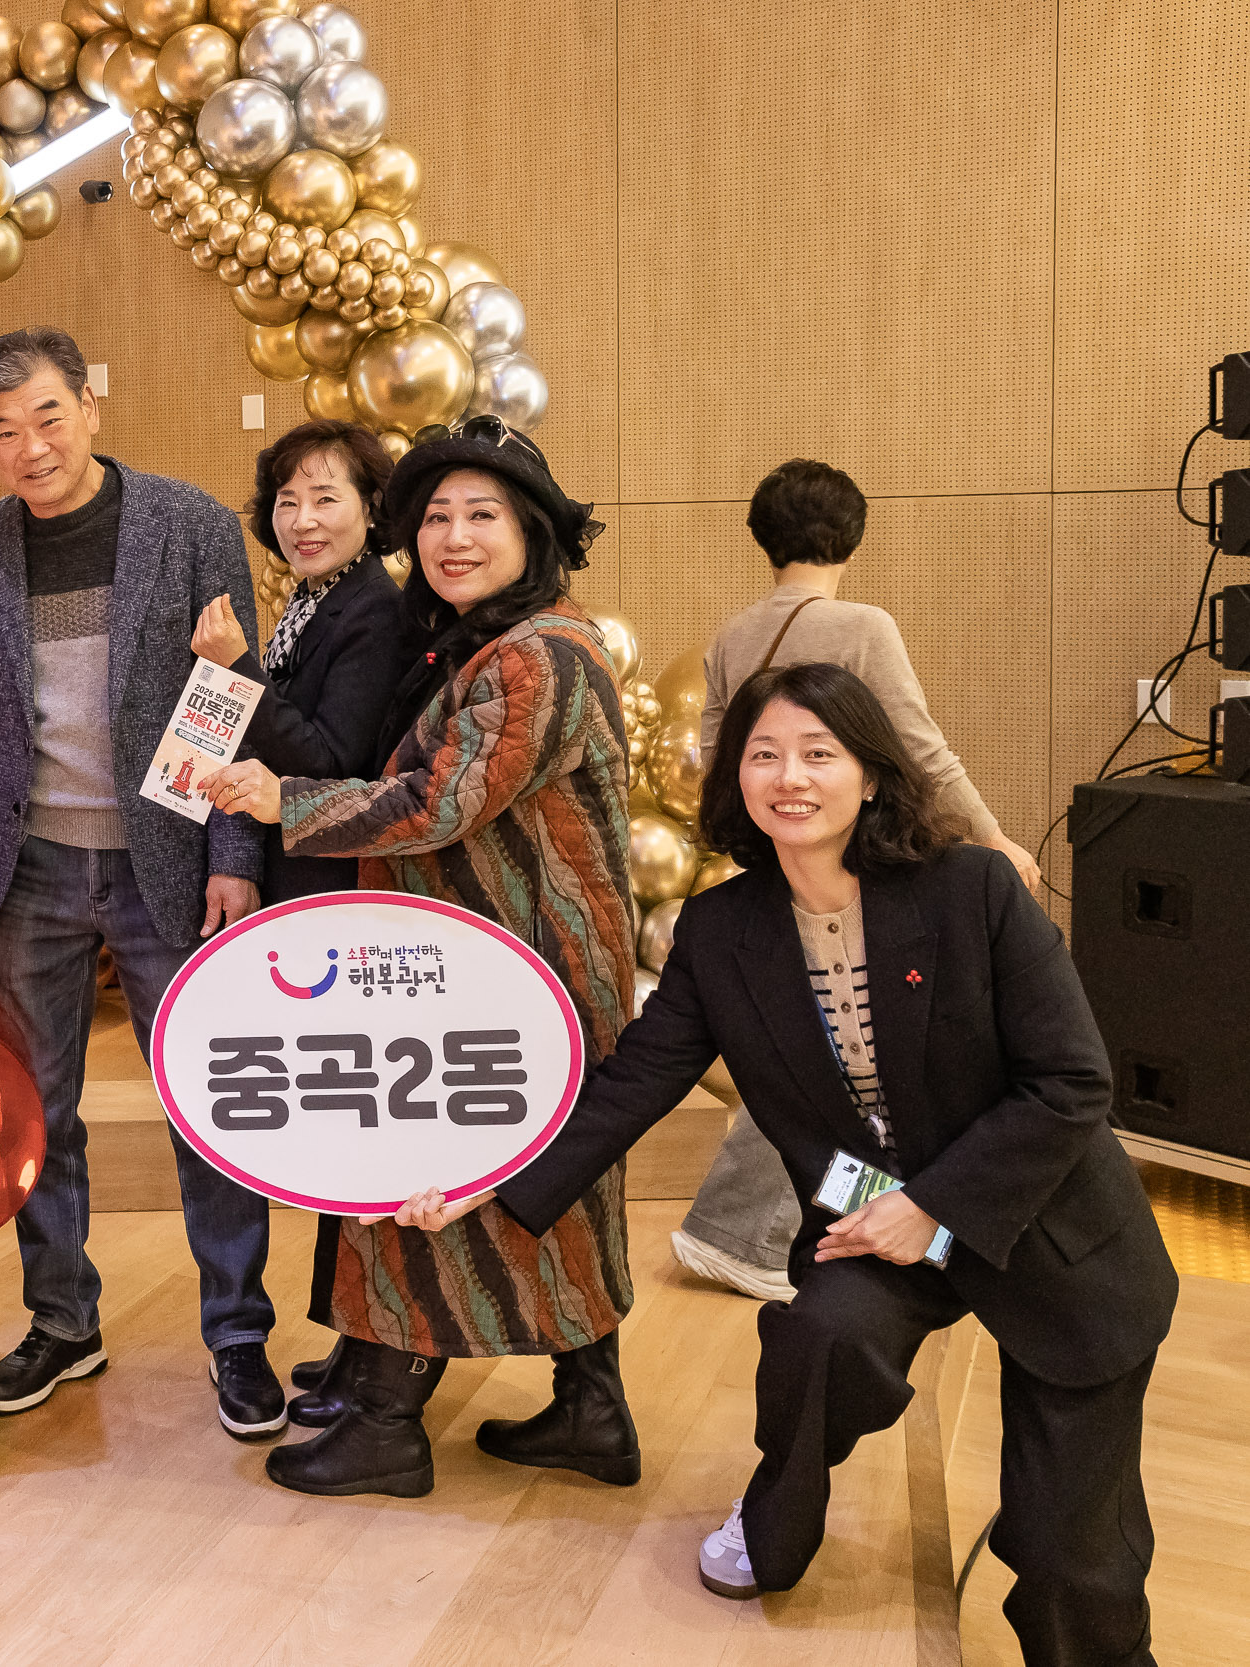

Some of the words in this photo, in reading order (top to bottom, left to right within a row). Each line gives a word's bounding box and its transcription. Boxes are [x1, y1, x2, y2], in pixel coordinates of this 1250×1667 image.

[194, 684, 214, 698] 2026
[182, 708, 234, 740] 겨울나기
[186, 692, 241, 728] 따뜻한
[347, 945, 393, 966] 소통하며
[394, 944, 444, 964] 발전하는
[207, 1029, 528, 1131] 중곡2동
